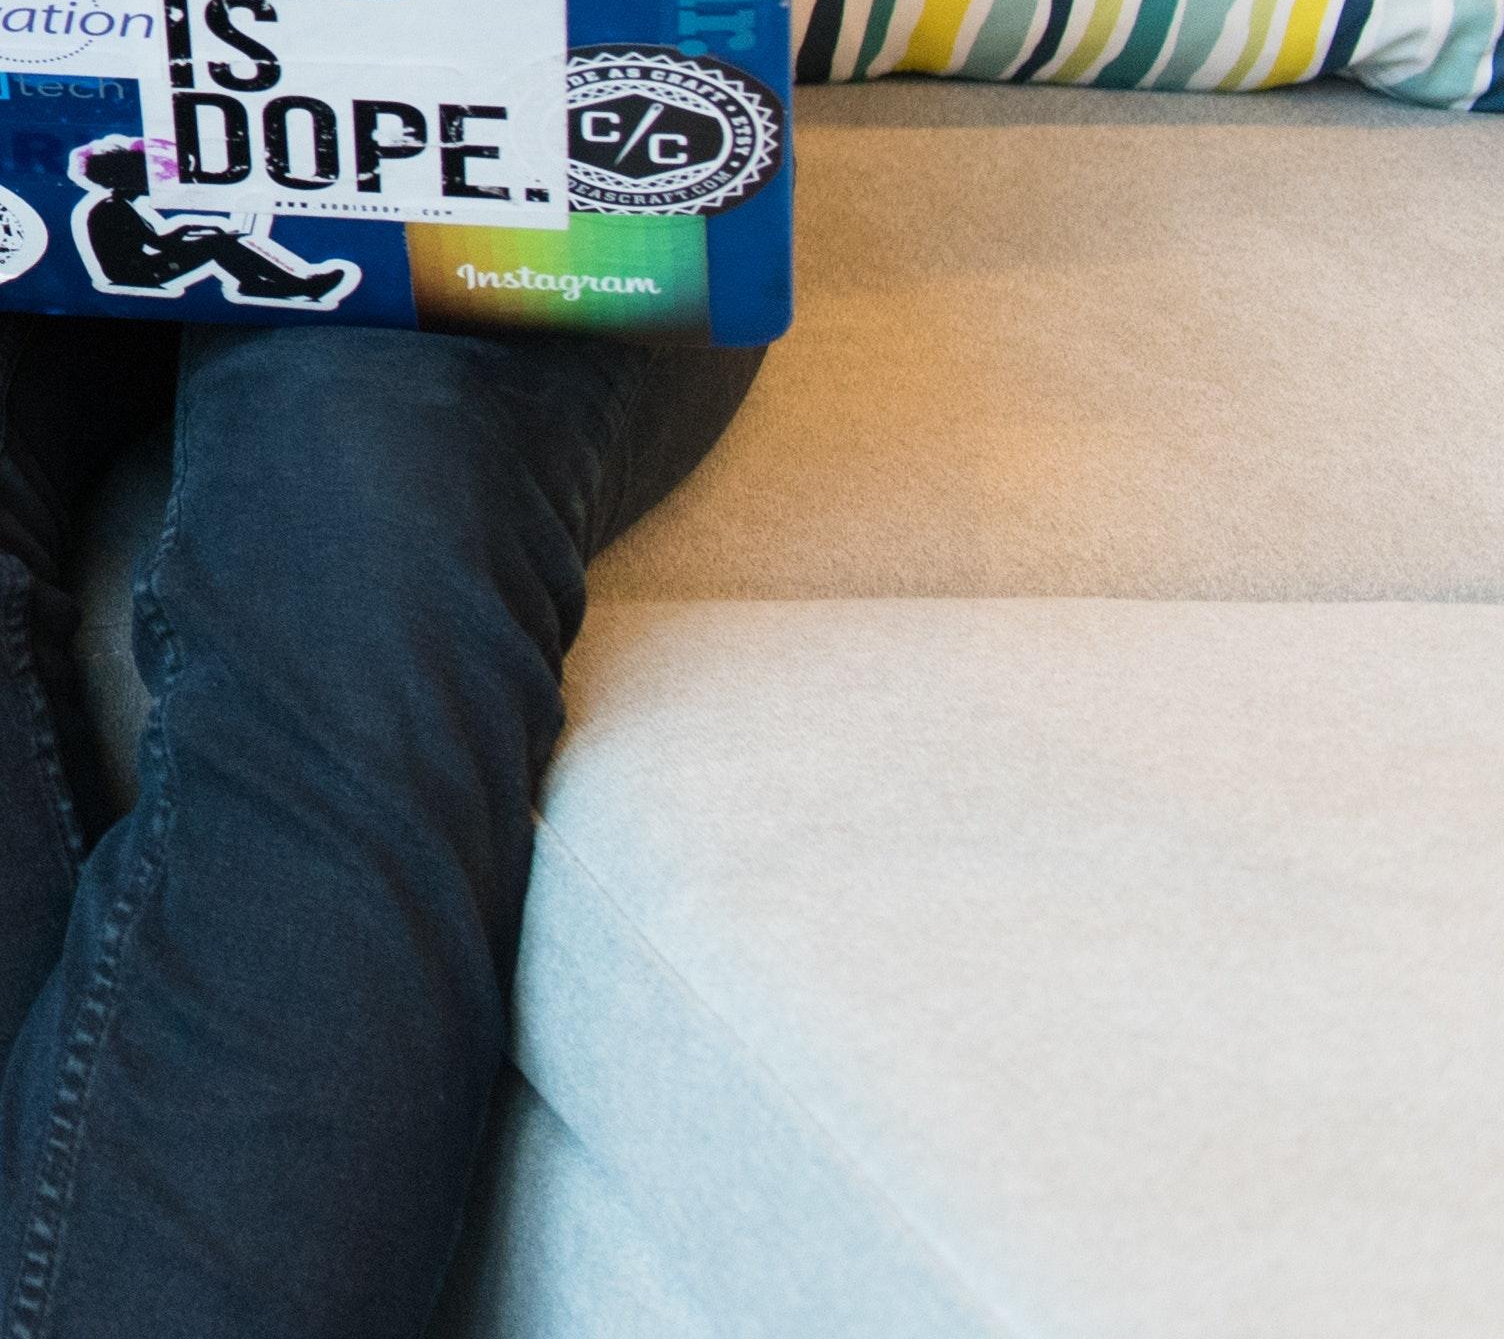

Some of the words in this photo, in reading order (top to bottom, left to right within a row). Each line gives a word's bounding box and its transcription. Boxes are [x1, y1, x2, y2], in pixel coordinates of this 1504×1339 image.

[608, 67, 642, 80] AS
[650, 69, 728, 103] CRAFT
[171, 90, 551, 205] DOPE.
[733, 114, 753, 157] ETSY
[569, 170, 733, 206] DEASCRAFT.COM
[456, 263, 663, 302] Instagram
